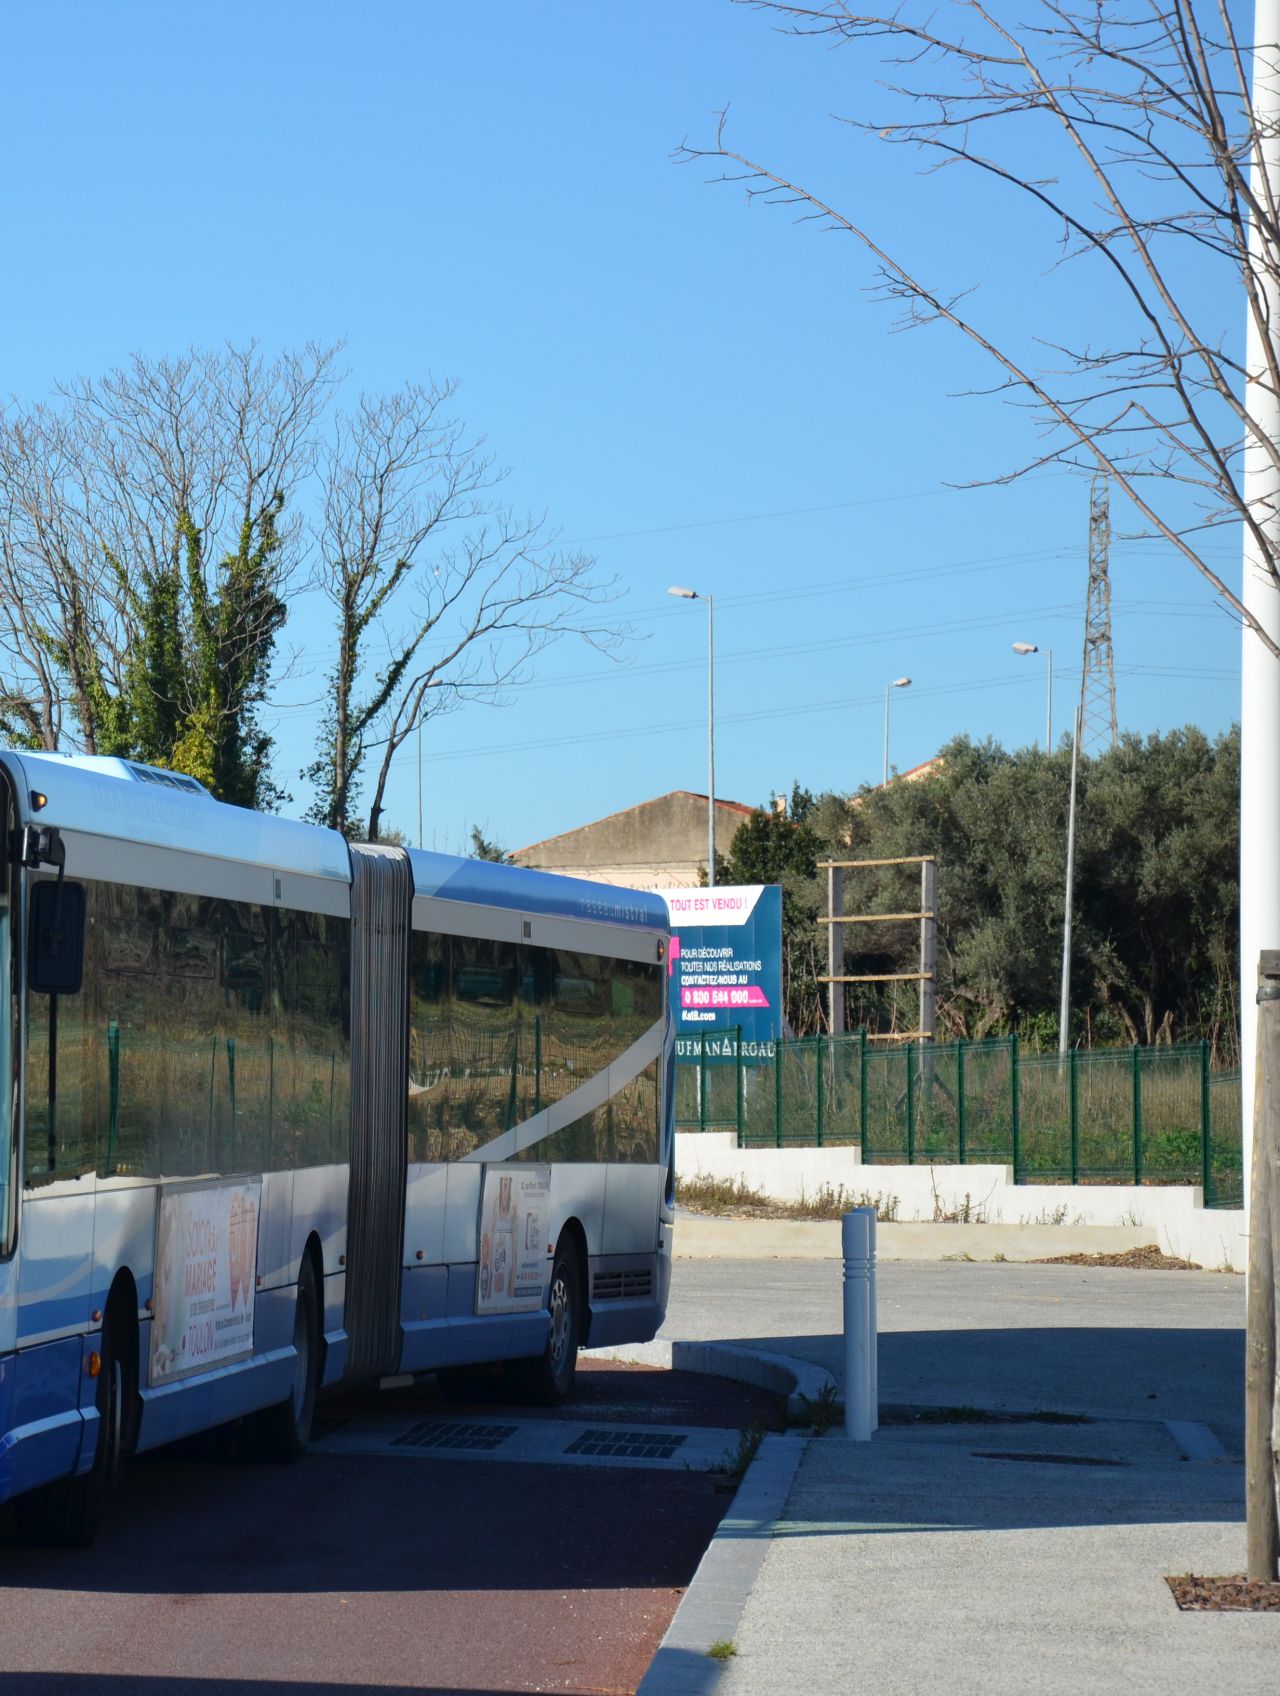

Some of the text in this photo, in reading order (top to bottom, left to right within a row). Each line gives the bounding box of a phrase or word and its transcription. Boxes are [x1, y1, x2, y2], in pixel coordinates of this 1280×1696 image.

[671, 899, 691, 911] TOUT
[695, 899, 710, 911] EST
[712, 898, 742, 910] VENDU
[681, 946, 733, 958] POUR DÉCOUVRIR
[681, 959, 762, 972] TOUTES NOS RÉALISATIONS
[681, 974, 748, 985] CONTACTEZ-NOUS AU
[684, 991, 691, 1004] 0
[693, 991, 709, 1004] 800
[731, 990, 748, 1003] 000
[184, 1258, 216, 1297] MARIAGE
[188, 1319, 214, 1356] TOULON
